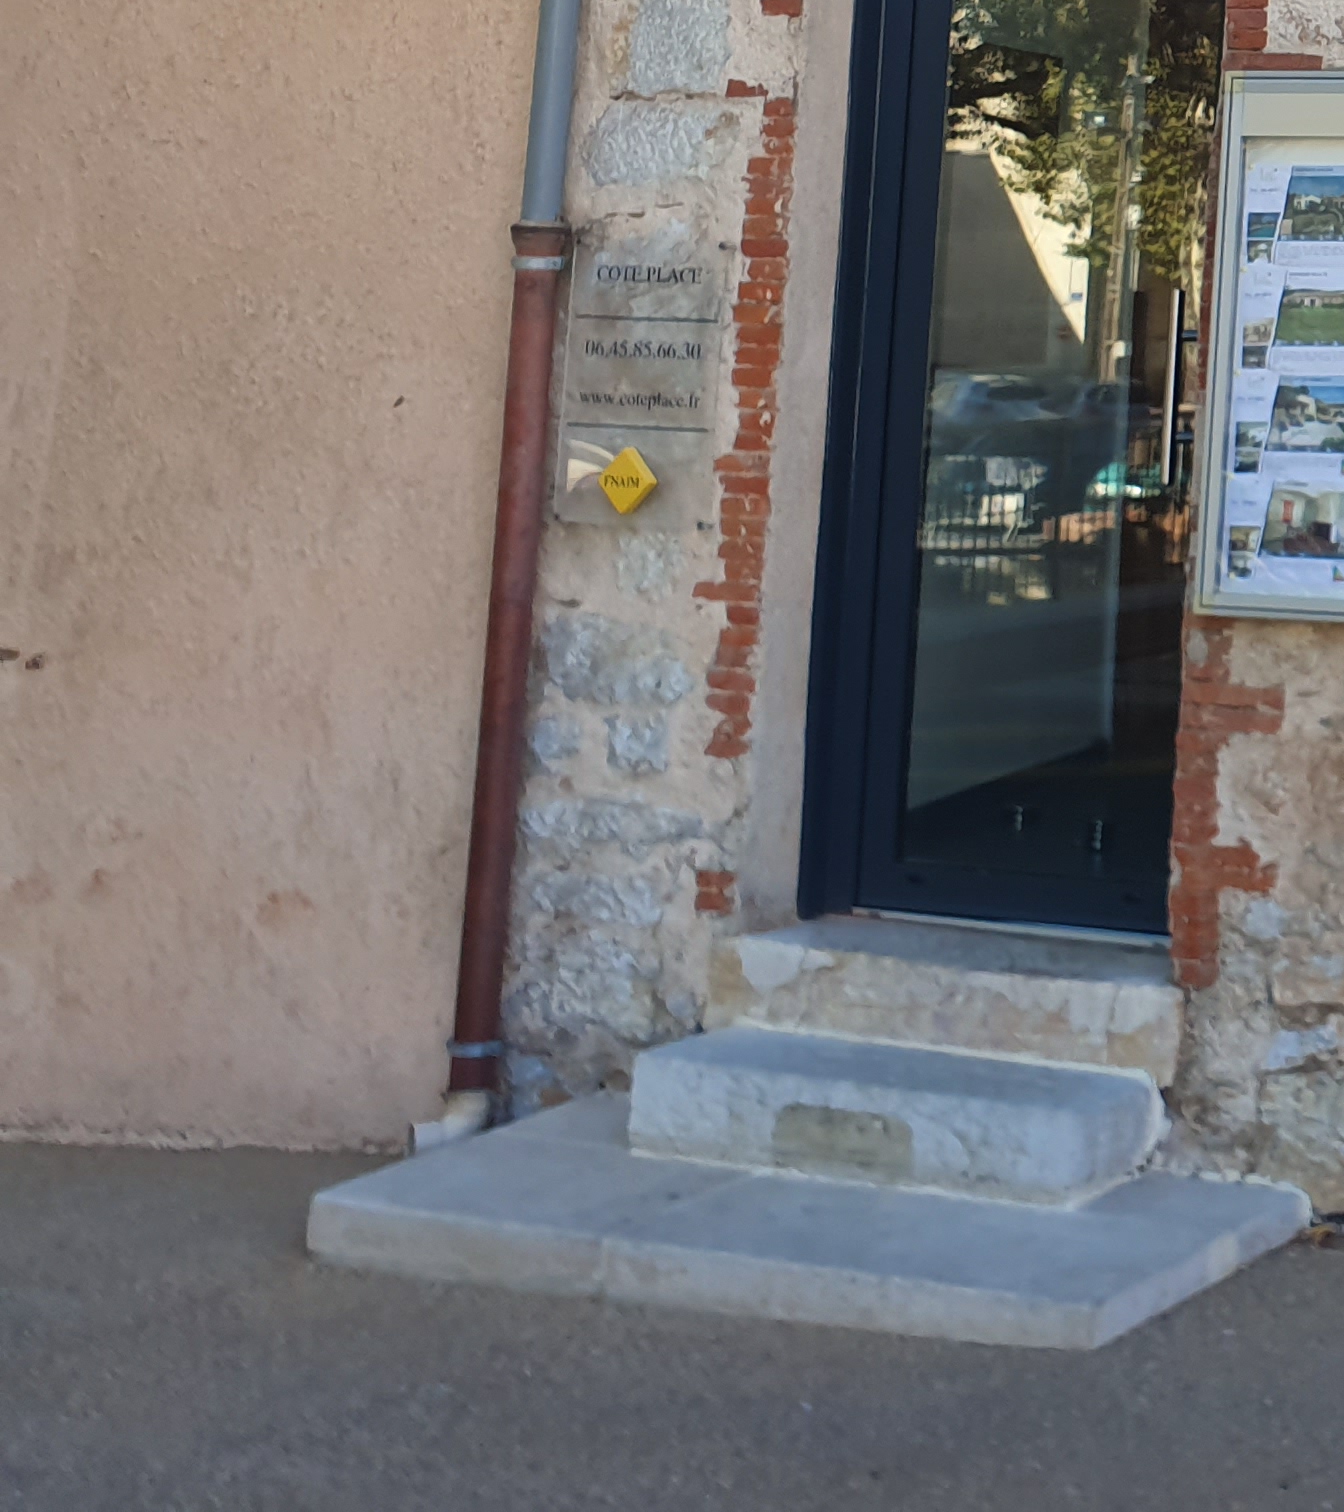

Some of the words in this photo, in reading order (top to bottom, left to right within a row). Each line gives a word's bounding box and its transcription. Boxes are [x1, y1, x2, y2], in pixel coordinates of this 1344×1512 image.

[646, 266, 702, 285] PLACE
[579, 390, 701, 411] www.coteplace.fr
[603, 474, 640, 489] FNAIM
